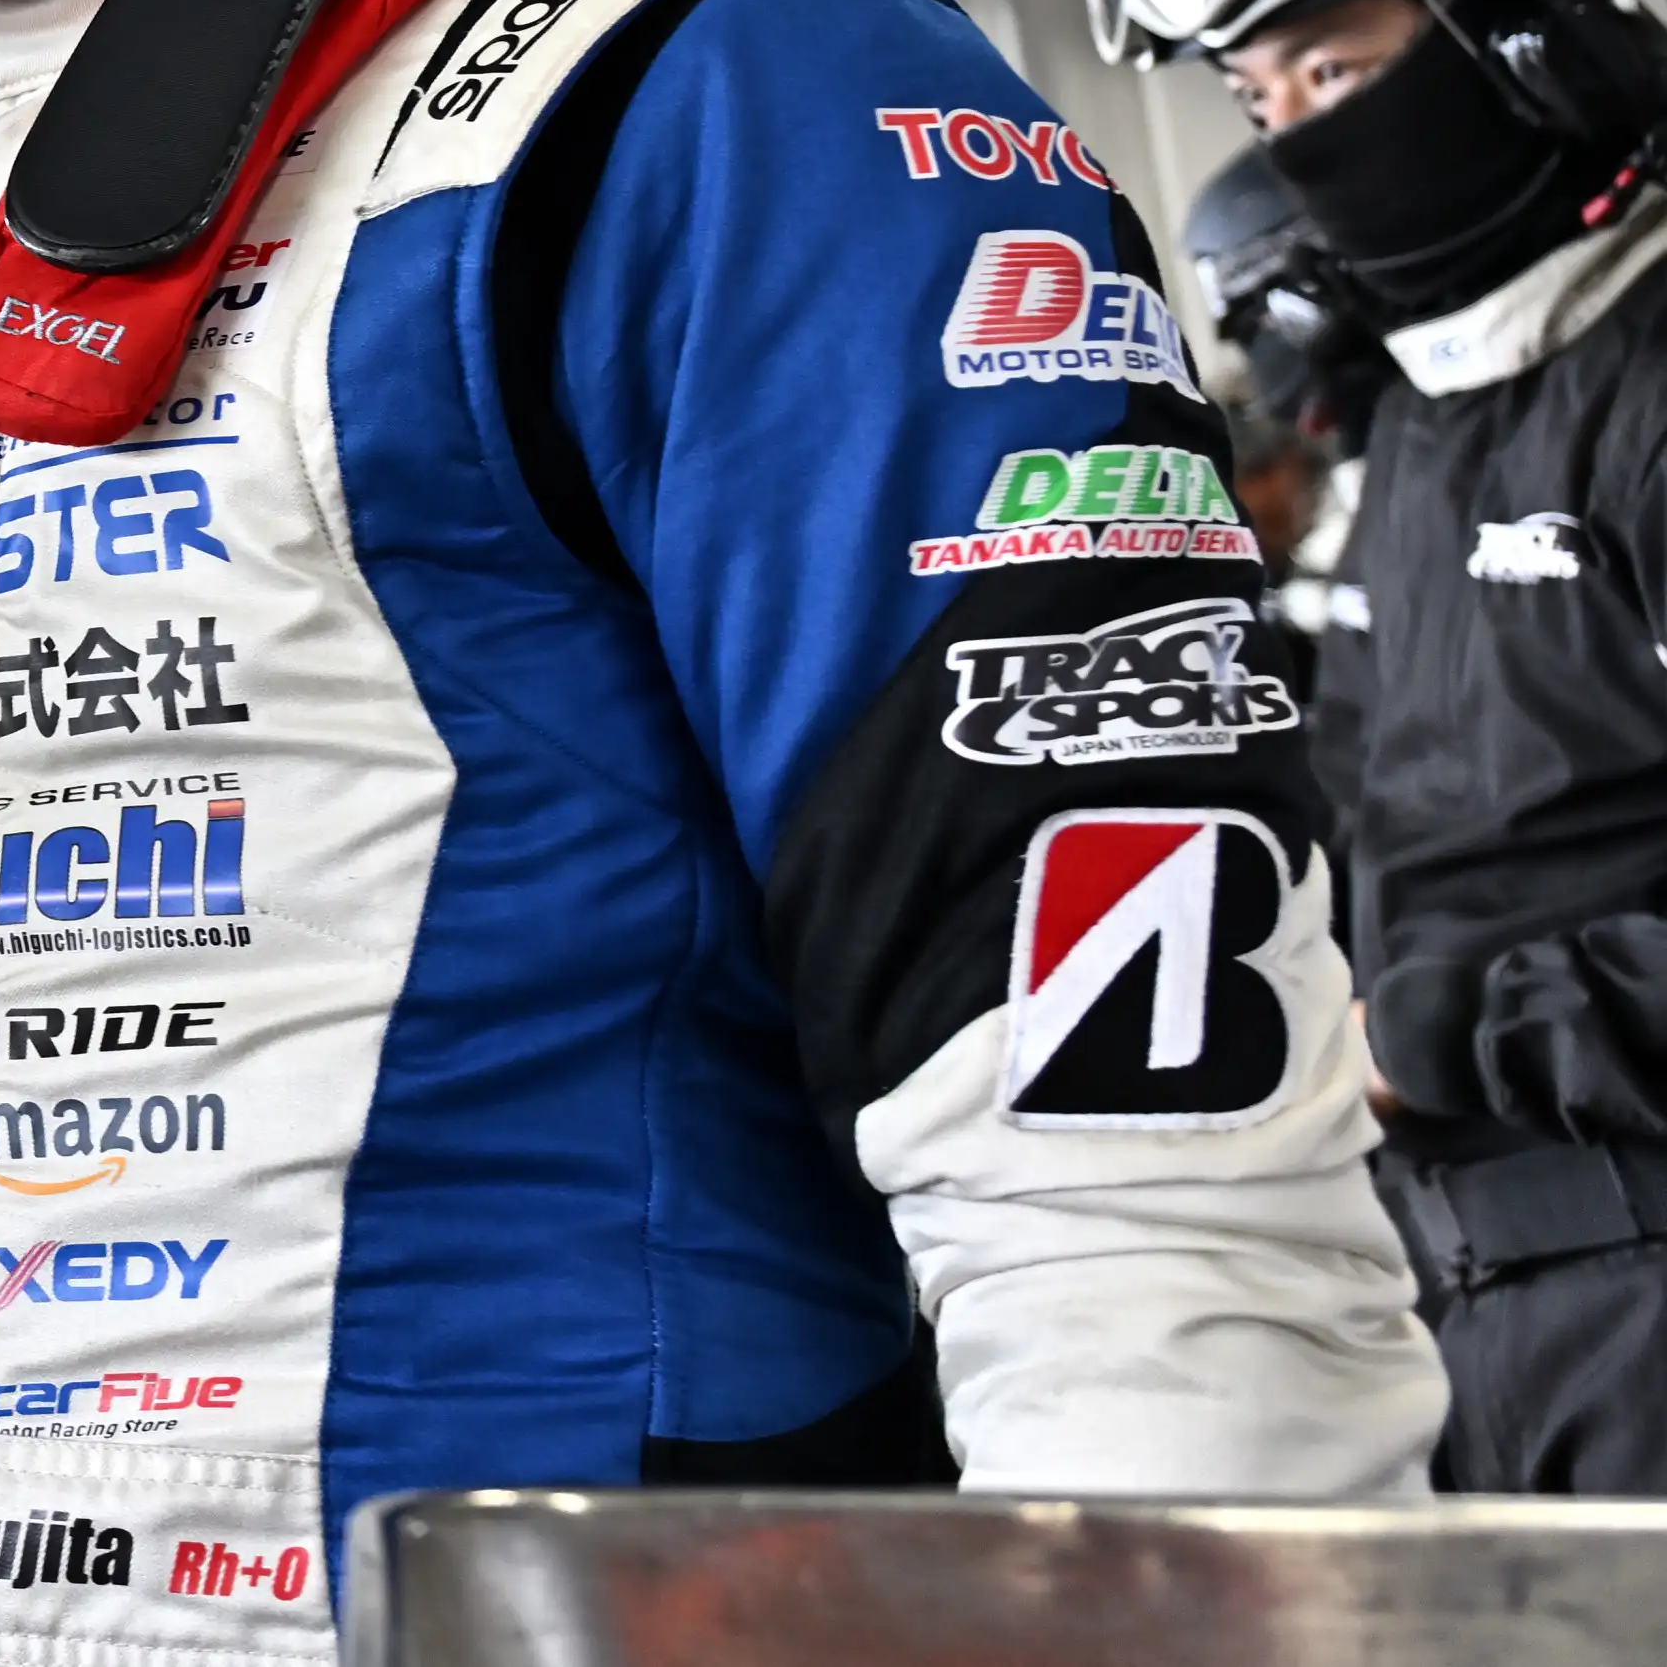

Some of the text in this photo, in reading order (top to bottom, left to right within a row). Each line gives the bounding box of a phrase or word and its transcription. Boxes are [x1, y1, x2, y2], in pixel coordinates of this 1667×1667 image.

[958, 347, 1112, 375] MOTOR
[985, 450, 1238, 525] DELTA
[916, 526, 1088, 571] TANAKA
[1101, 528, 1184, 556] AUTO
[1062, 737, 1124, 758] JAPAN
[28, 771, 244, 808] SERVICE
[49, 1421, 120, 1440] Racing
[121, 1417, 180, 1435] Store
